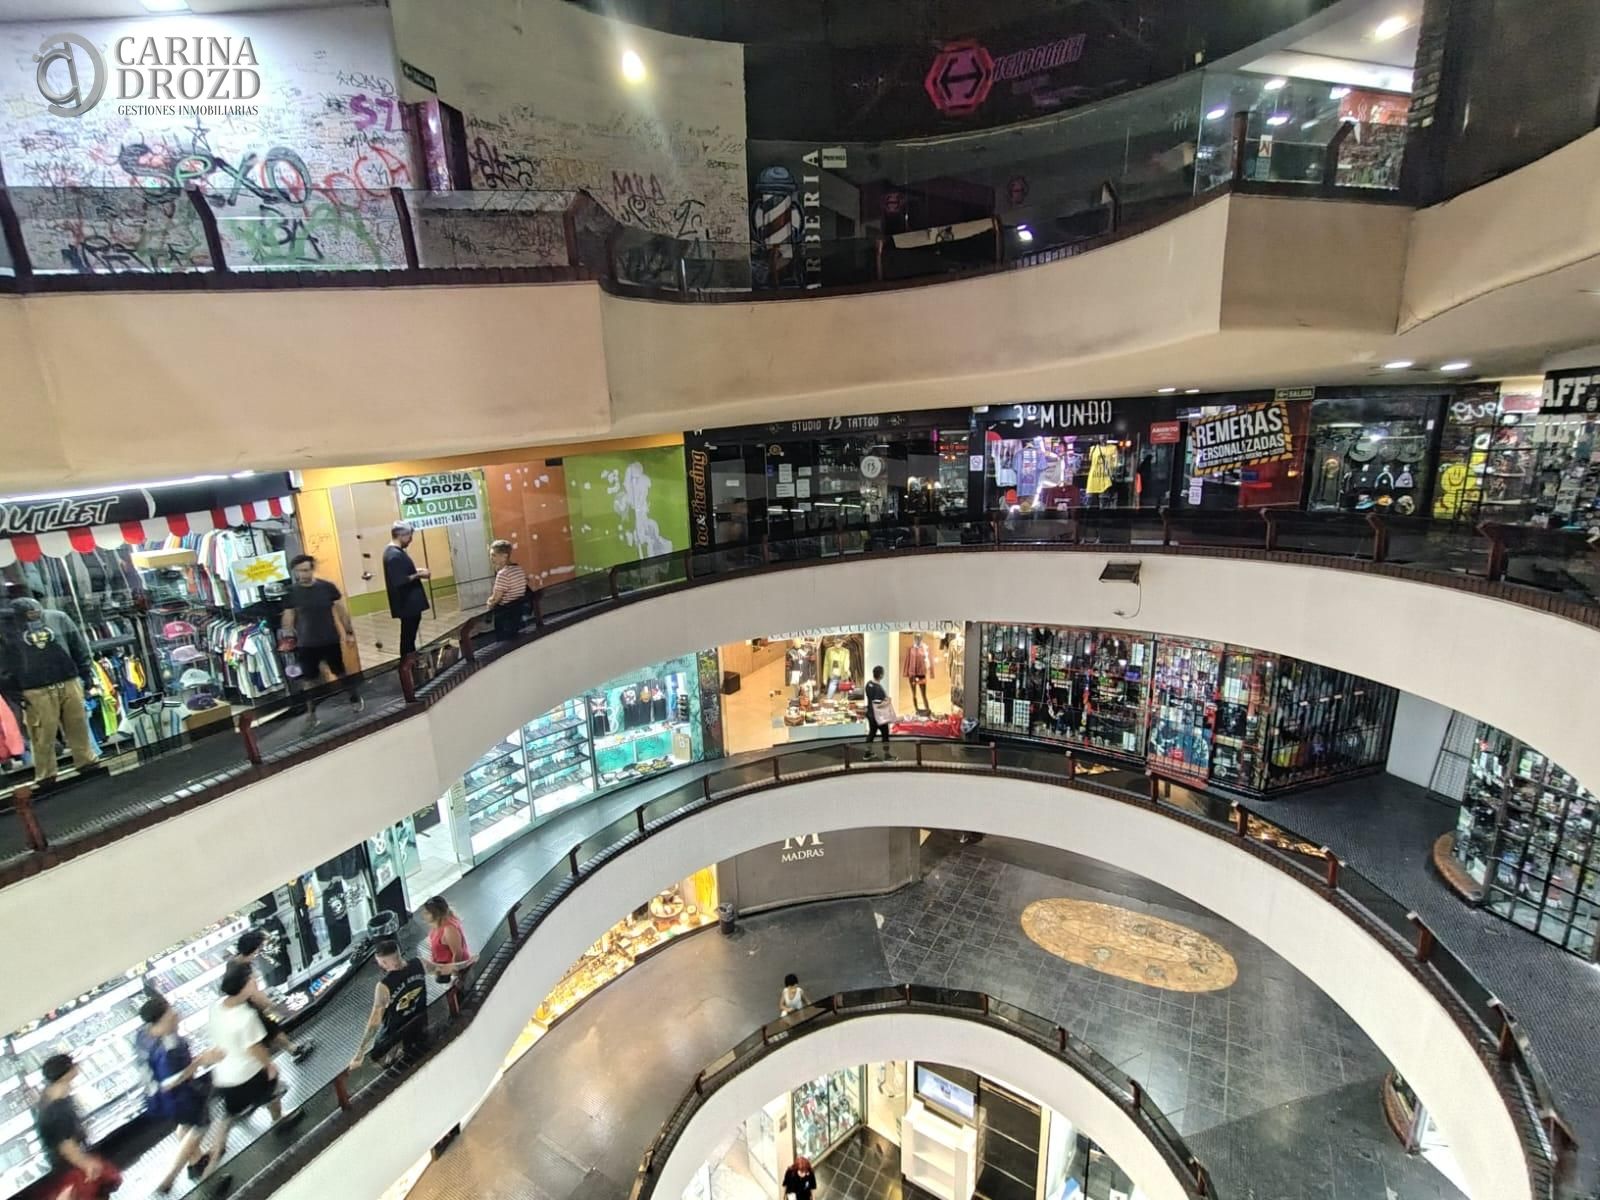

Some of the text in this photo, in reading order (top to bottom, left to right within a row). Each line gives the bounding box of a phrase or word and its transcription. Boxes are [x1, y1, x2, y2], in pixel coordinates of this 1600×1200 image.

[1040, 400, 1111, 428] MUNDO
[792, 421, 821, 432] STUDIO
[1196, 407, 1283, 447] REMERAS
[1196, 433, 1285, 463] PERSONALIZADAS
[419, 472, 472, 486] CARINA
[421, 482, 473, 495] DROZD
[406, 497, 475, 517] ALQUILA
[781, 848, 825, 863] MADRAS
